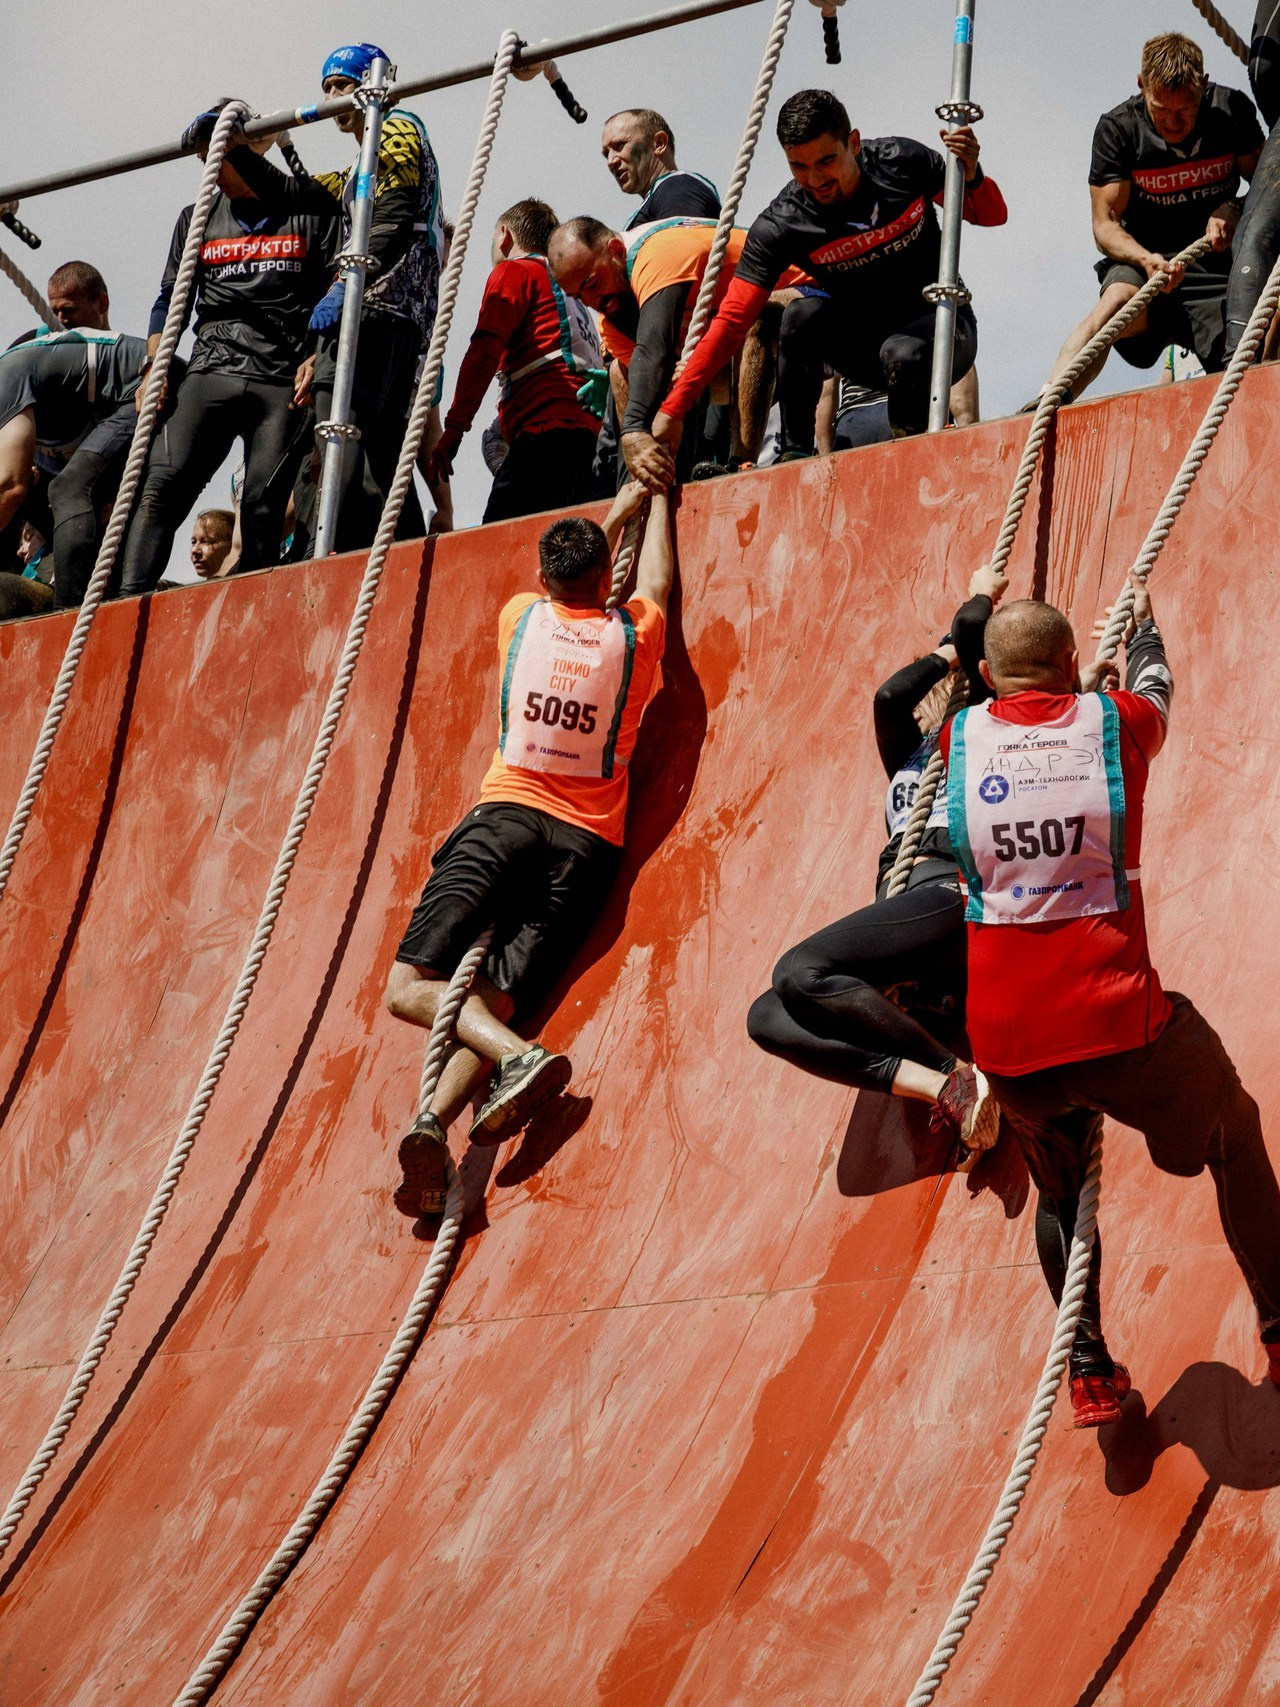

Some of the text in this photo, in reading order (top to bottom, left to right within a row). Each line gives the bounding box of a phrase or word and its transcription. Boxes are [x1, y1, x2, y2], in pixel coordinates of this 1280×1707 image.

[1136, 160, 1233, 190] ИНСТРУКТО
[250, 259, 302, 274] ГЕРОЕВ
[549, 674, 577, 693] CITY
[523, 691, 599, 735] 5095
[998, 739, 1068, 751] ГОНКА ГЕРОЕВ
[1017, 774, 1091, 786] АЭМ-ТЕХНОЛОГИИ
[1018, 785, 1048, 793] РОСАТОМ
[991, 815, 1086, 862] 5507
[1028, 881, 1085, 896] ГАЗПРОМБАНК
